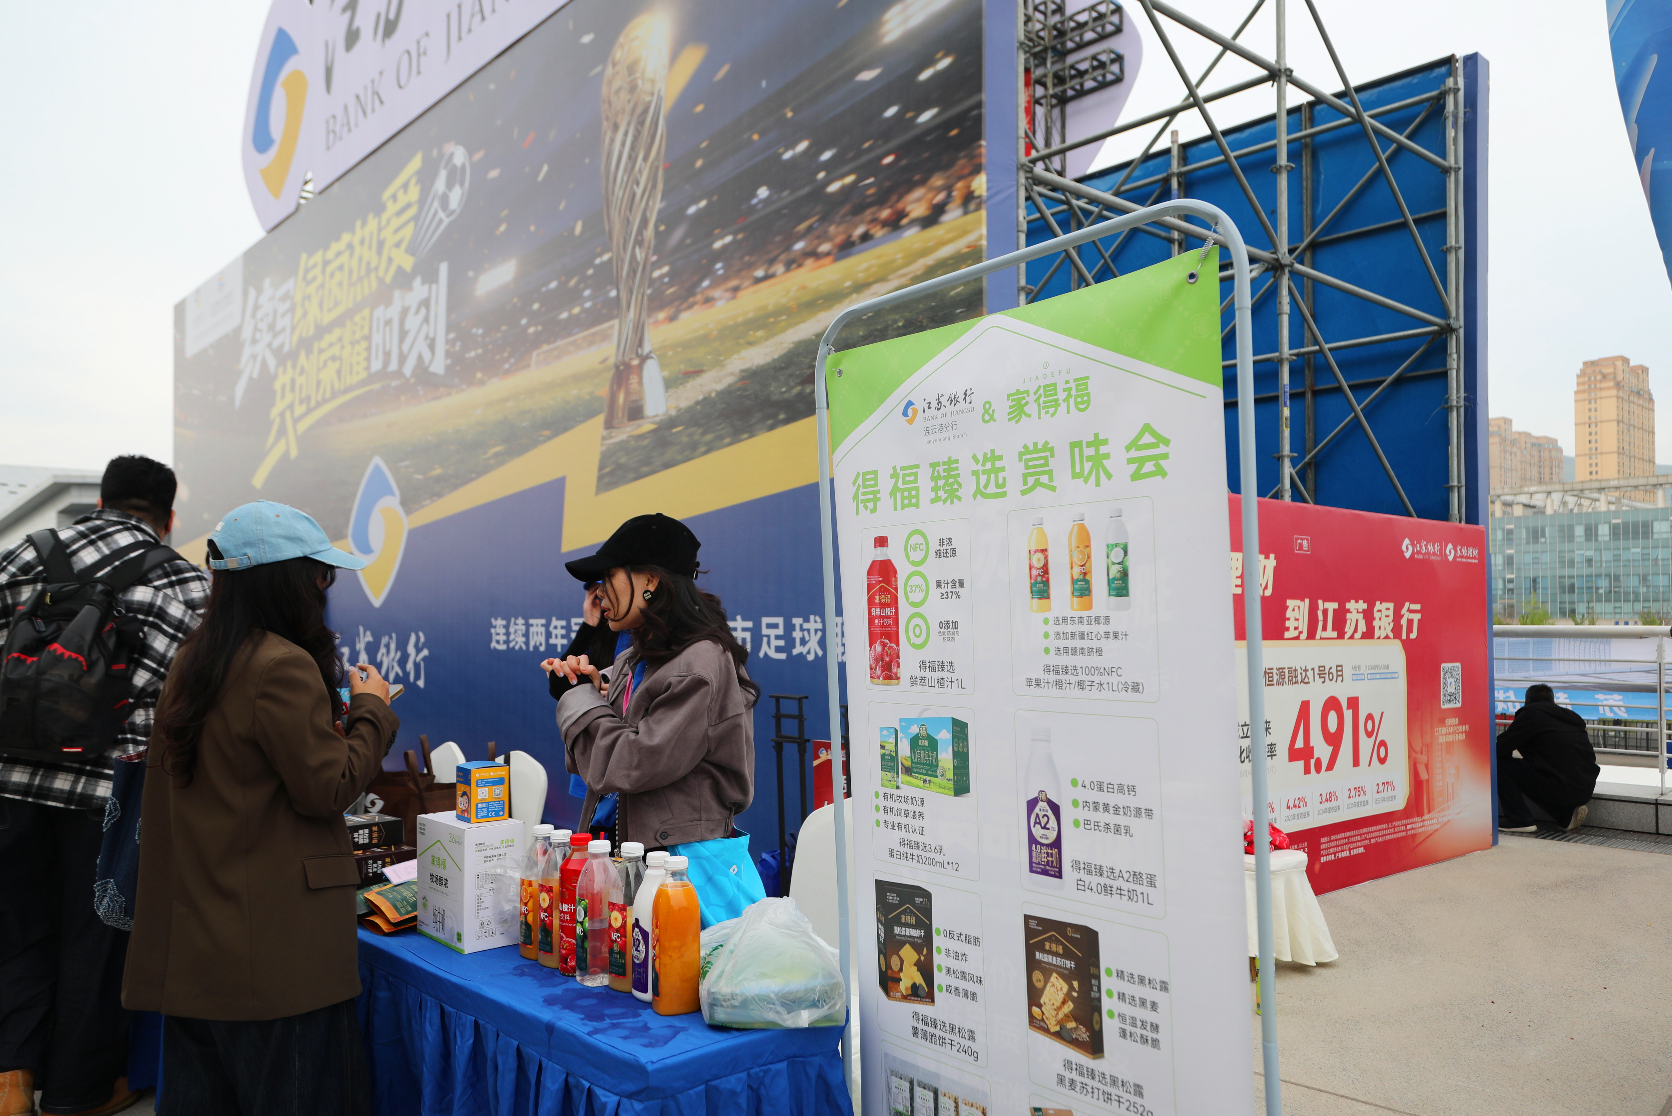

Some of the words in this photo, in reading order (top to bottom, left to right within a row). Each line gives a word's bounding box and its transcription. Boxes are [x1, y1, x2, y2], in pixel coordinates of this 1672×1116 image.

[325, 69, 386, 153] BANK
[395, 31, 431, 90] OF
[1022, 367, 1073, 384] JIADEFU
[922, 387, 975, 414] 江苏银行
[1007, 375, 1092, 424] 家得福
[982, 401, 997, 424] &
[852, 422, 1172, 516] 得福臻选赏味会
[909, 543, 924, 553] NFC
[938, 537, 953, 548] 非浓
[1296, 538, 1309, 551] 广告
[935, 547, 958, 559] 缩还原
[908, 584, 925, 594] 37%
[935, 578, 966, 590] 果汁含量
[940, 591, 961, 600] ≥37%
[938, 620, 959, 631] 0添加
[1053, 615, 1111, 626] 选用东南亚椰源
[1284, 598, 1422, 640] 到江苏银行
[1053, 631, 1129, 641] 添加新疆红心苹果汁
[1054, 646, 1103, 657] 选用赣南脐橙
[918, 660, 956, 674] 得福臻选
[1042, 664, 1123, 678] 得福臻选100%NFC
[1263, 664, 1344, 688] 恒源融达1号6月
[909, 675, 967, 690] 鲜萃山楂汁1L
[1025, 677, 1145, 694] 苹果汁/橙汁/椰子水1L(冷藏)
[1288, 695, 1389, 776] 4.91%
[1081, 780, 1137, 797] 4.0蛋白高钙
[1348, 785, 1367, 799] 2.75%
[1376, 780, 1396, 795] 2.77%
[882, 792, 925, 808] 有机牧场奶源
[1286, 796, 1308, 811] 4.42%
[1319, 791, 1339, 804] 3.48%
[1082, 800, 1154, 821] 内蒙黄金奶源带
[882, 819, 926, 837] 专业有机认证
[1033, 812, 1051, 831] A2
[1083, 818, 1134, 838] 巴氏杀菌乳
[1070, 859, 1158, 889] 得福臻选A2酪蛋
[1076, 878, 1155, 907] 白4.0鲜牛奶1L
[943, 929, 982, 948] 0反式脂肪
[944, 947, 969, 964] 非油炸
[945, 966, 984, 987] 黑松露风味
[1115, 968, 1170, 995] 精选黑松露
[945, 984, 979, 1003] 咸香薄脆
[1117, 990, 1160, 1015] 精选黑麦
[911, 1010, 977, 1044] 得福臻选黑松露
[1118, 1011, 1161, 1036] 恒温发酵
[910, 1025, 980, 1063] 薯薄脆饼干240g
[1118, 1026, 1162, 1052] 蓬松酥脆
[1062, 1058, 1145, 1100] 得福臻选黑松露
